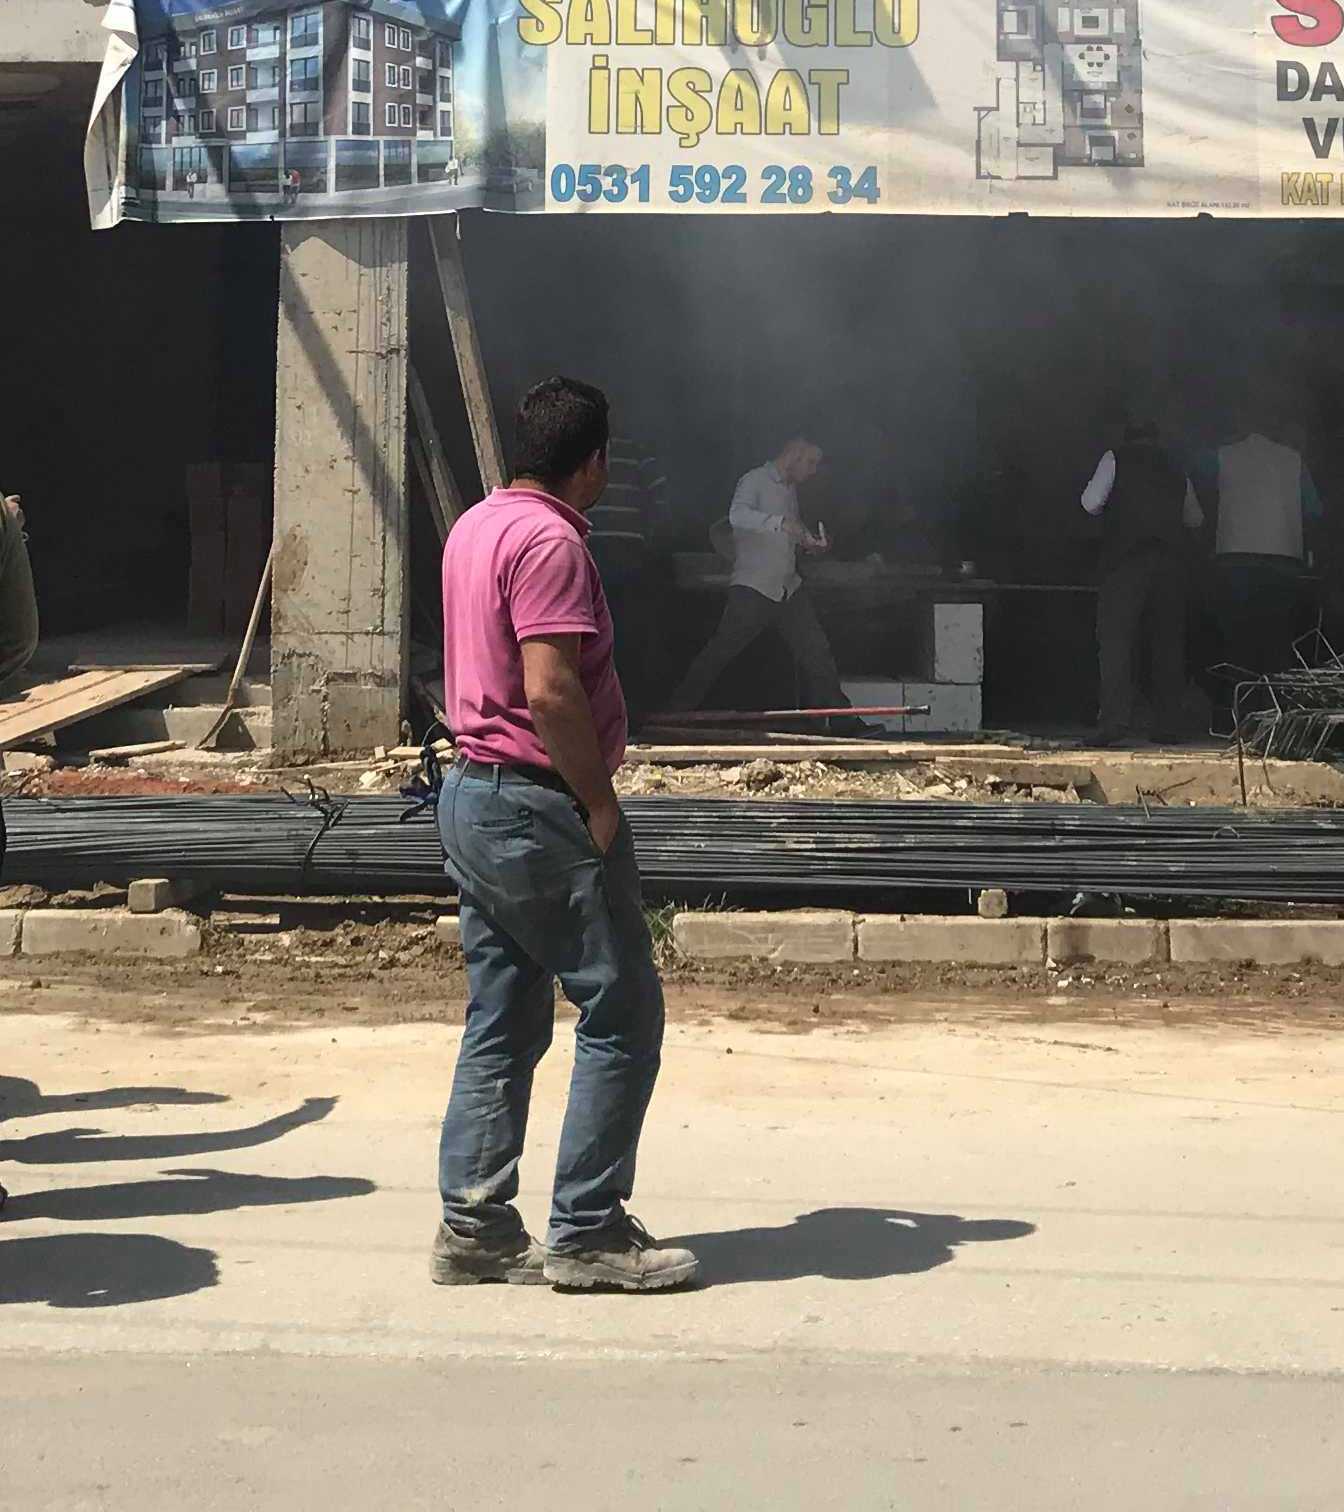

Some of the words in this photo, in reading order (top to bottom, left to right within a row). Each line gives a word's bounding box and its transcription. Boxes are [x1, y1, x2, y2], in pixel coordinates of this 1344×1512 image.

[587, 53, 851, 148] İNŞAAT
[550, 163, 651, 203] 0531
[668, 164, 748, 204] 592
[760, 164, 814, 205] 28
[826, 165, 881, 205] 34
[1280, 171, 1333, 206] KAT
